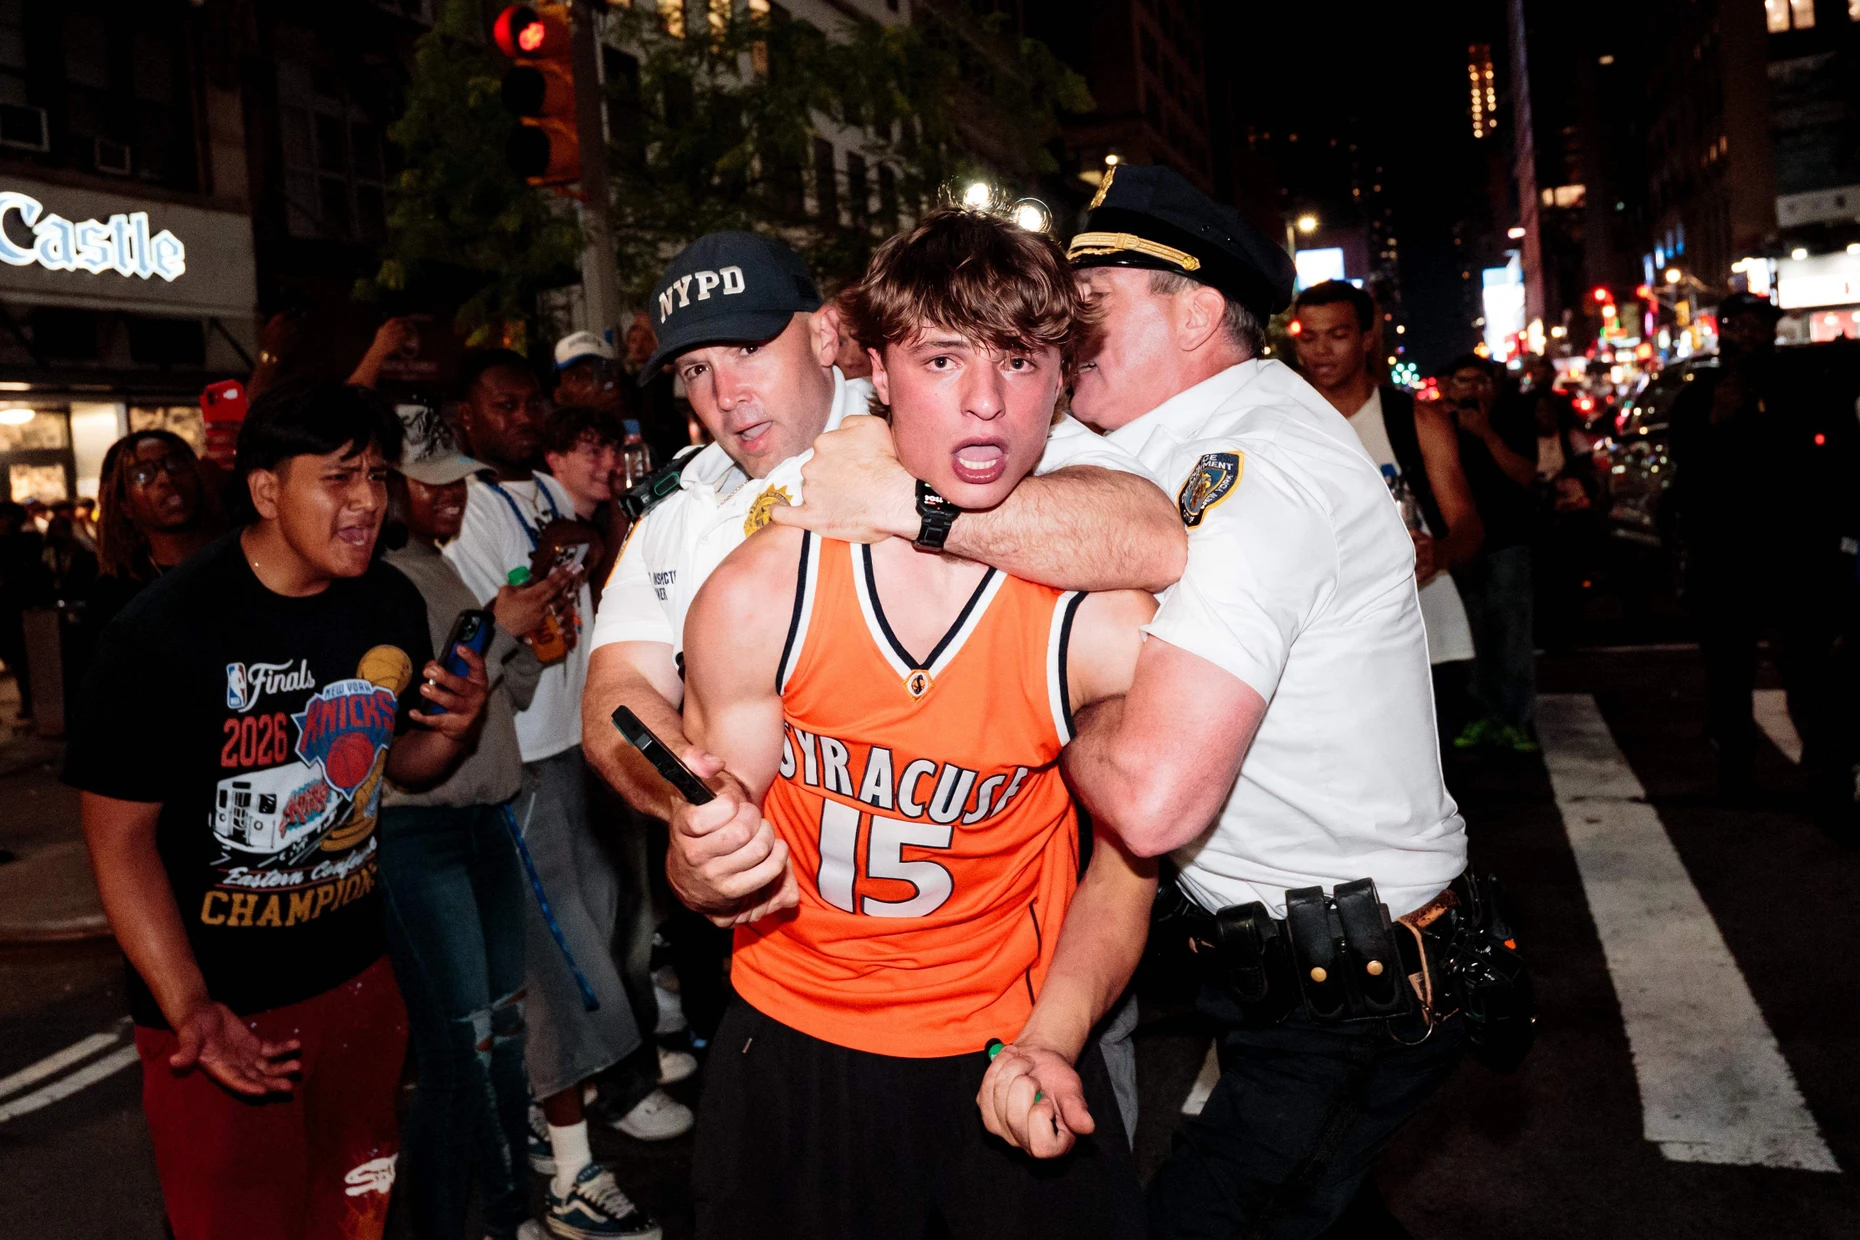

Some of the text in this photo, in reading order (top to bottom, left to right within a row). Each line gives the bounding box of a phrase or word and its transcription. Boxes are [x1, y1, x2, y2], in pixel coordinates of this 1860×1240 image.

[0, 191, 186, 282] Castle
[658, 265, 746, 324] NYPD
[238, 659, 316, 713] Finals
[324, 681, 372, 698] NEW YORK
[220, 712, 288, 768] 2026
[301, 690, 395, 751] KNICKS
[223, 866, 304, 888] Eastern
[817, 797, 954, 919] 15
[201, 862, 377, 927] CHAMPION
